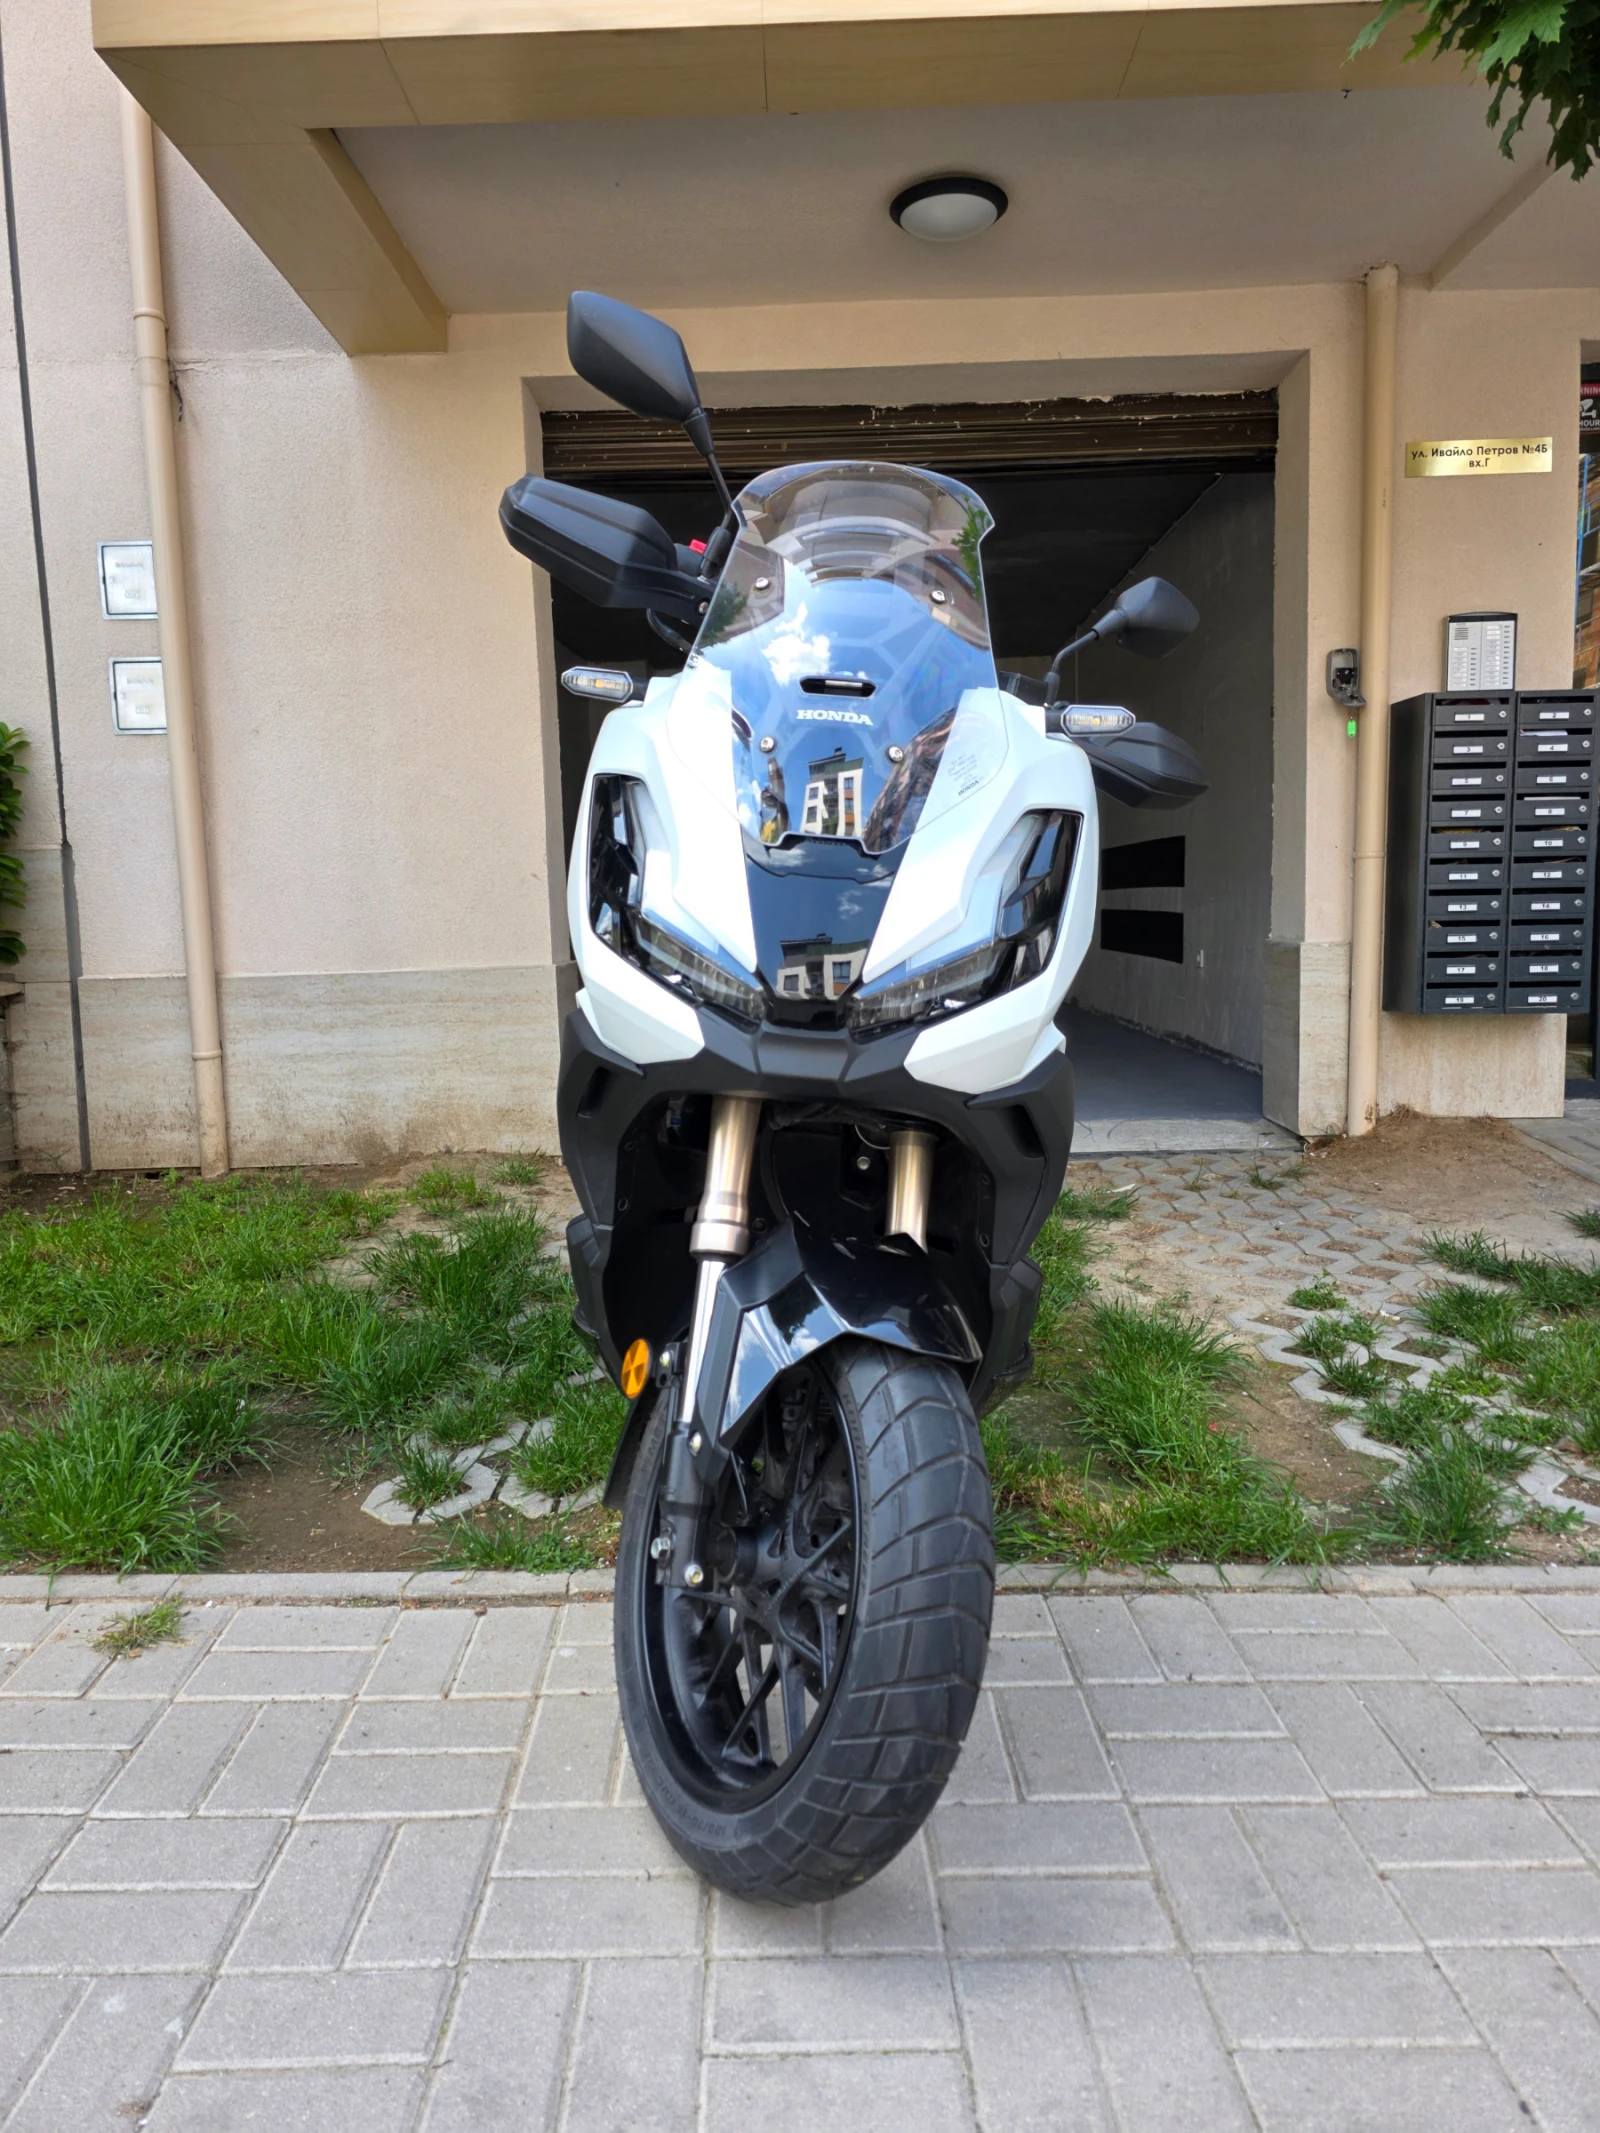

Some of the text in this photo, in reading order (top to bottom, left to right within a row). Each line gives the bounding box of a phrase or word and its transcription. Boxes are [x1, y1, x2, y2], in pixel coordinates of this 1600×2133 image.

[1411, 450, 1428, 460] ул.
[1431, 447, 1473, 457] Ивайло
[1476, 446, 1519, 456] Петров
[796, 709, 874, 726] HONDA
[957, 779, 980, 797] HONDA
